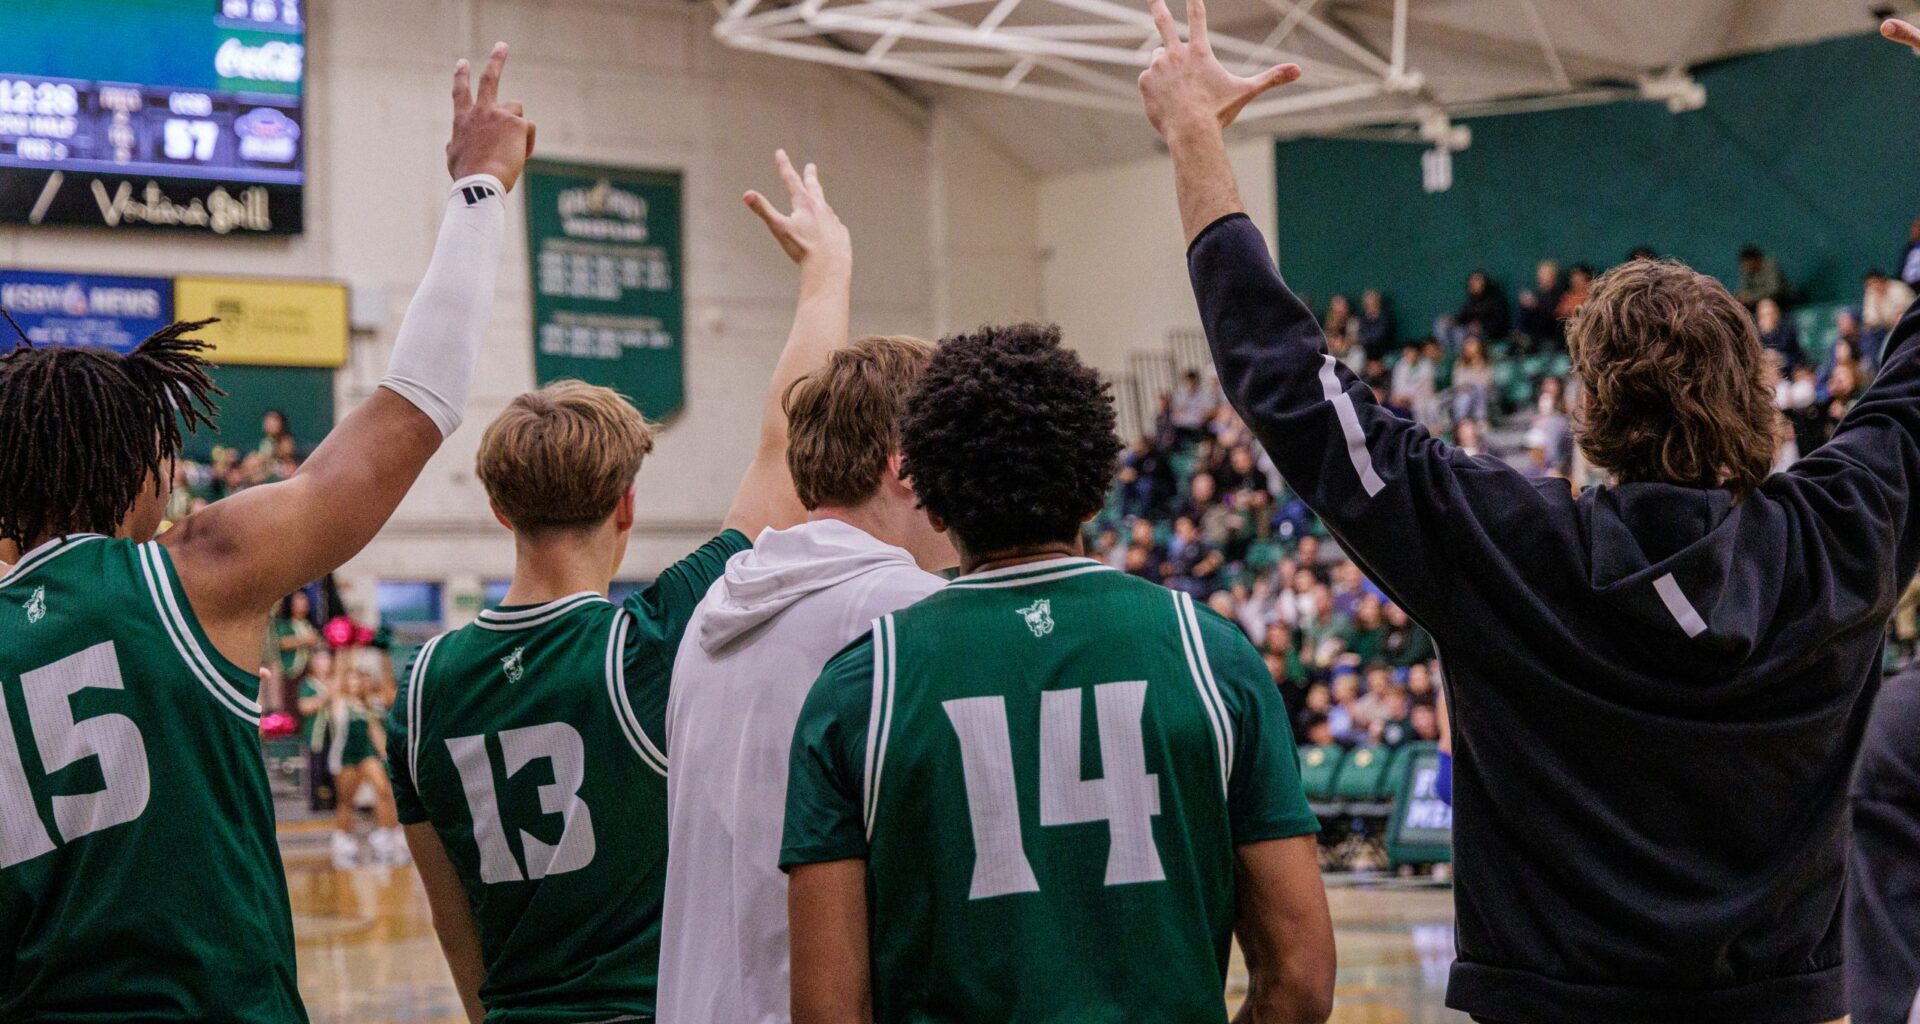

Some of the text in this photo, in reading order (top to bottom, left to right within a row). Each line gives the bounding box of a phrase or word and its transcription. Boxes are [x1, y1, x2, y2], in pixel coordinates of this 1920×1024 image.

[164, 118, 220, 161] 57
[89, 286, 160, 319] NEWS
[444, 721, 596, 884] 13
[941, 680, 1166, 900] 14
